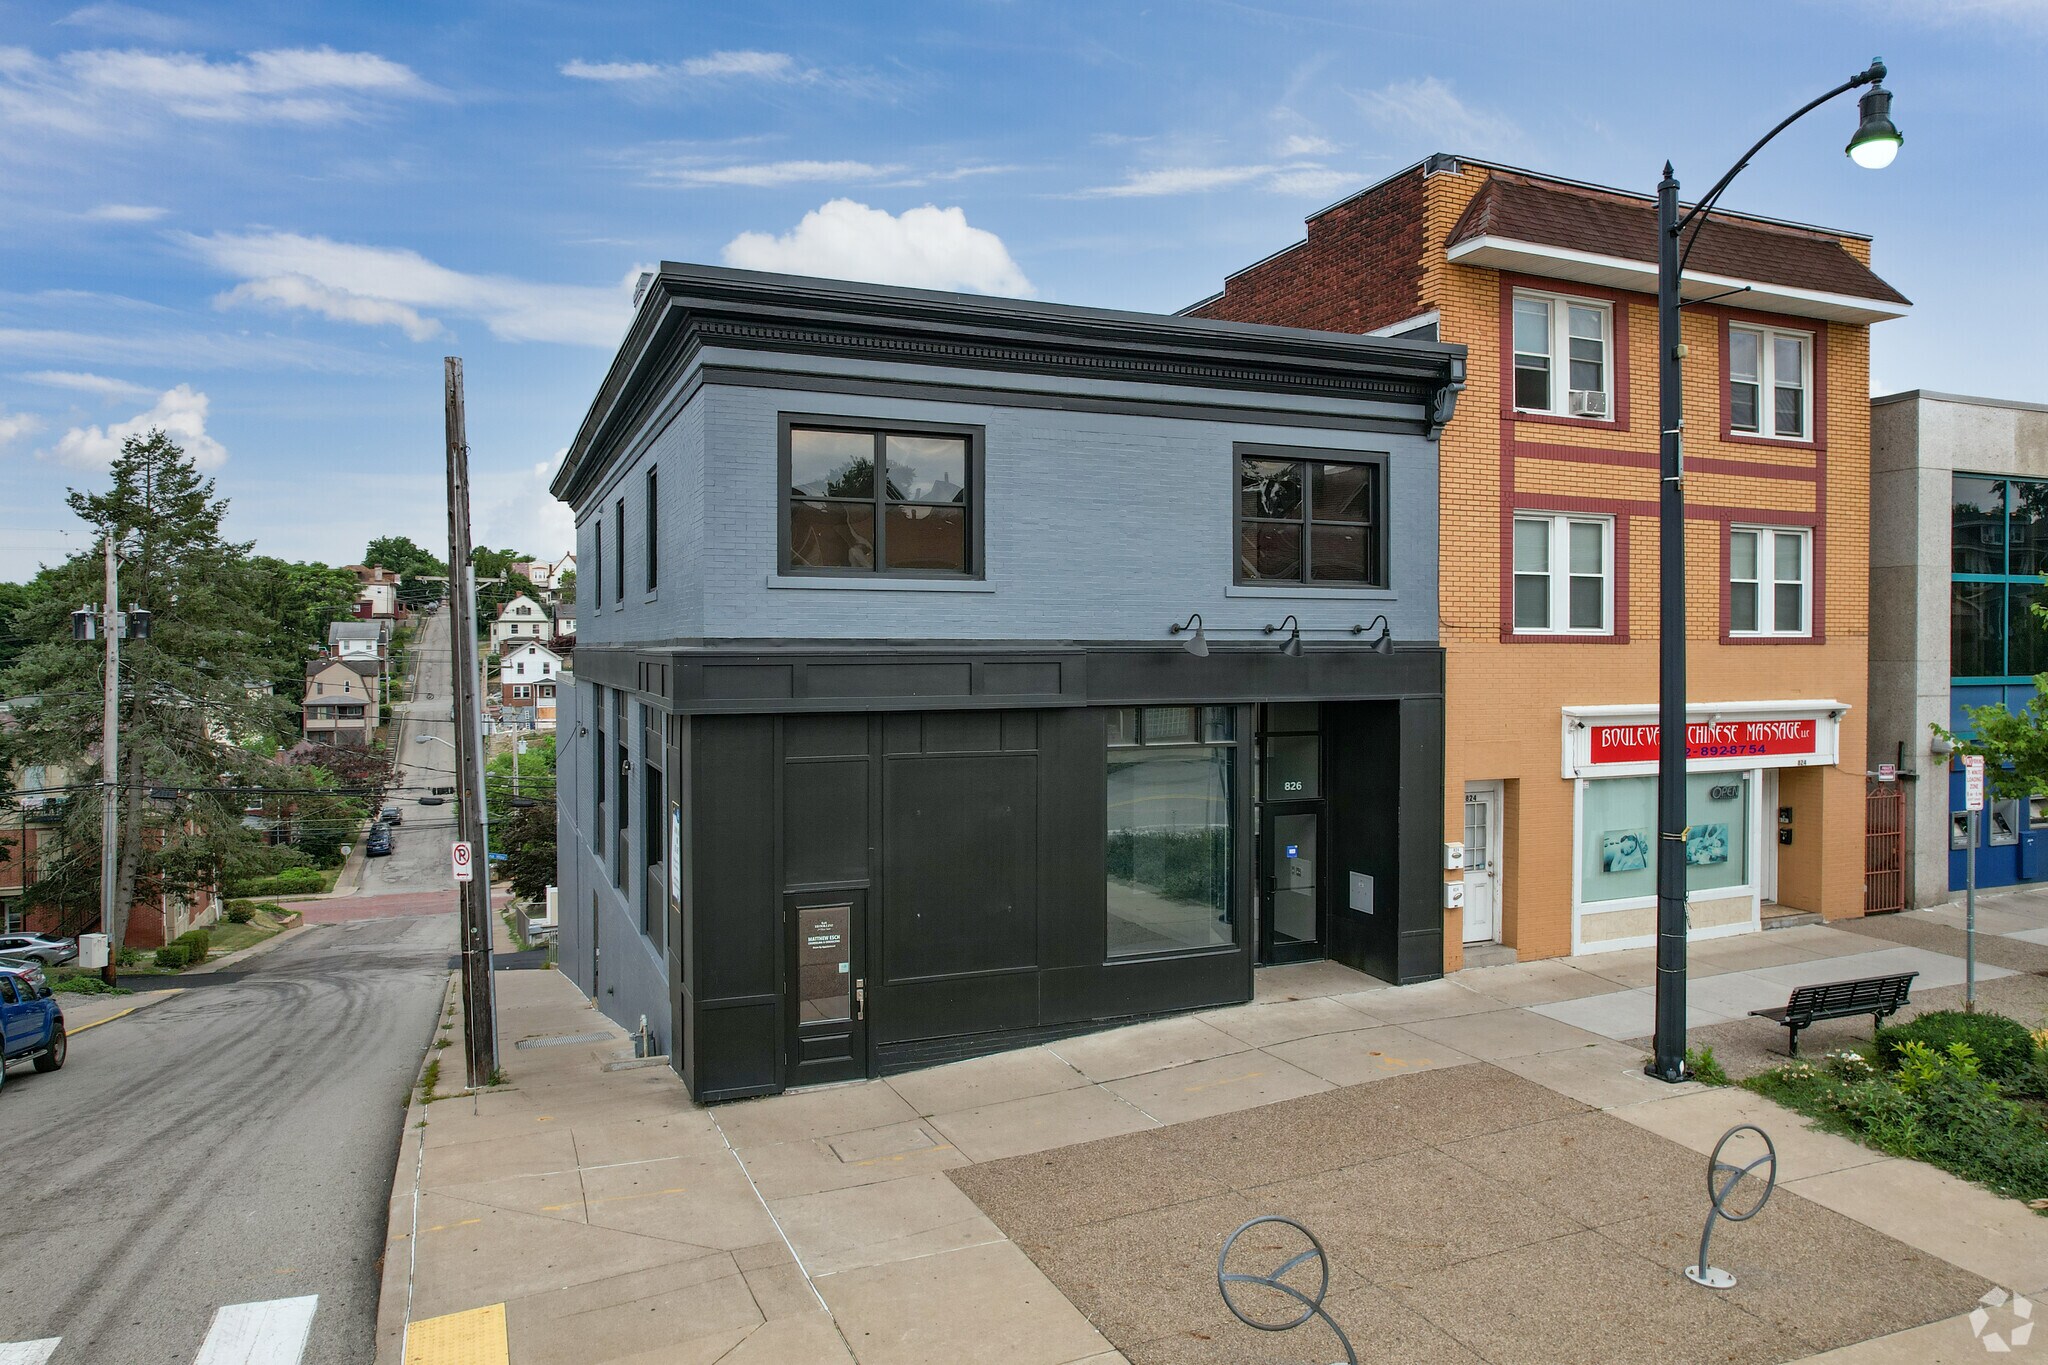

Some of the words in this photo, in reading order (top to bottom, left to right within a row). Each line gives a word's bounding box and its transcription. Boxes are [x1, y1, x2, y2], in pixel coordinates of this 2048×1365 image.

[1601, 726, 1660, 748] BOULEVA
[1687, 724, 1739, 744] CHINESE
[1746, 721, 1801, 742] MASSAGE
[1801, 730, 1810, 738] LLC
[1284, 781, 1302, 791] 826
[1712, 786, 1739, 799] OPEN
